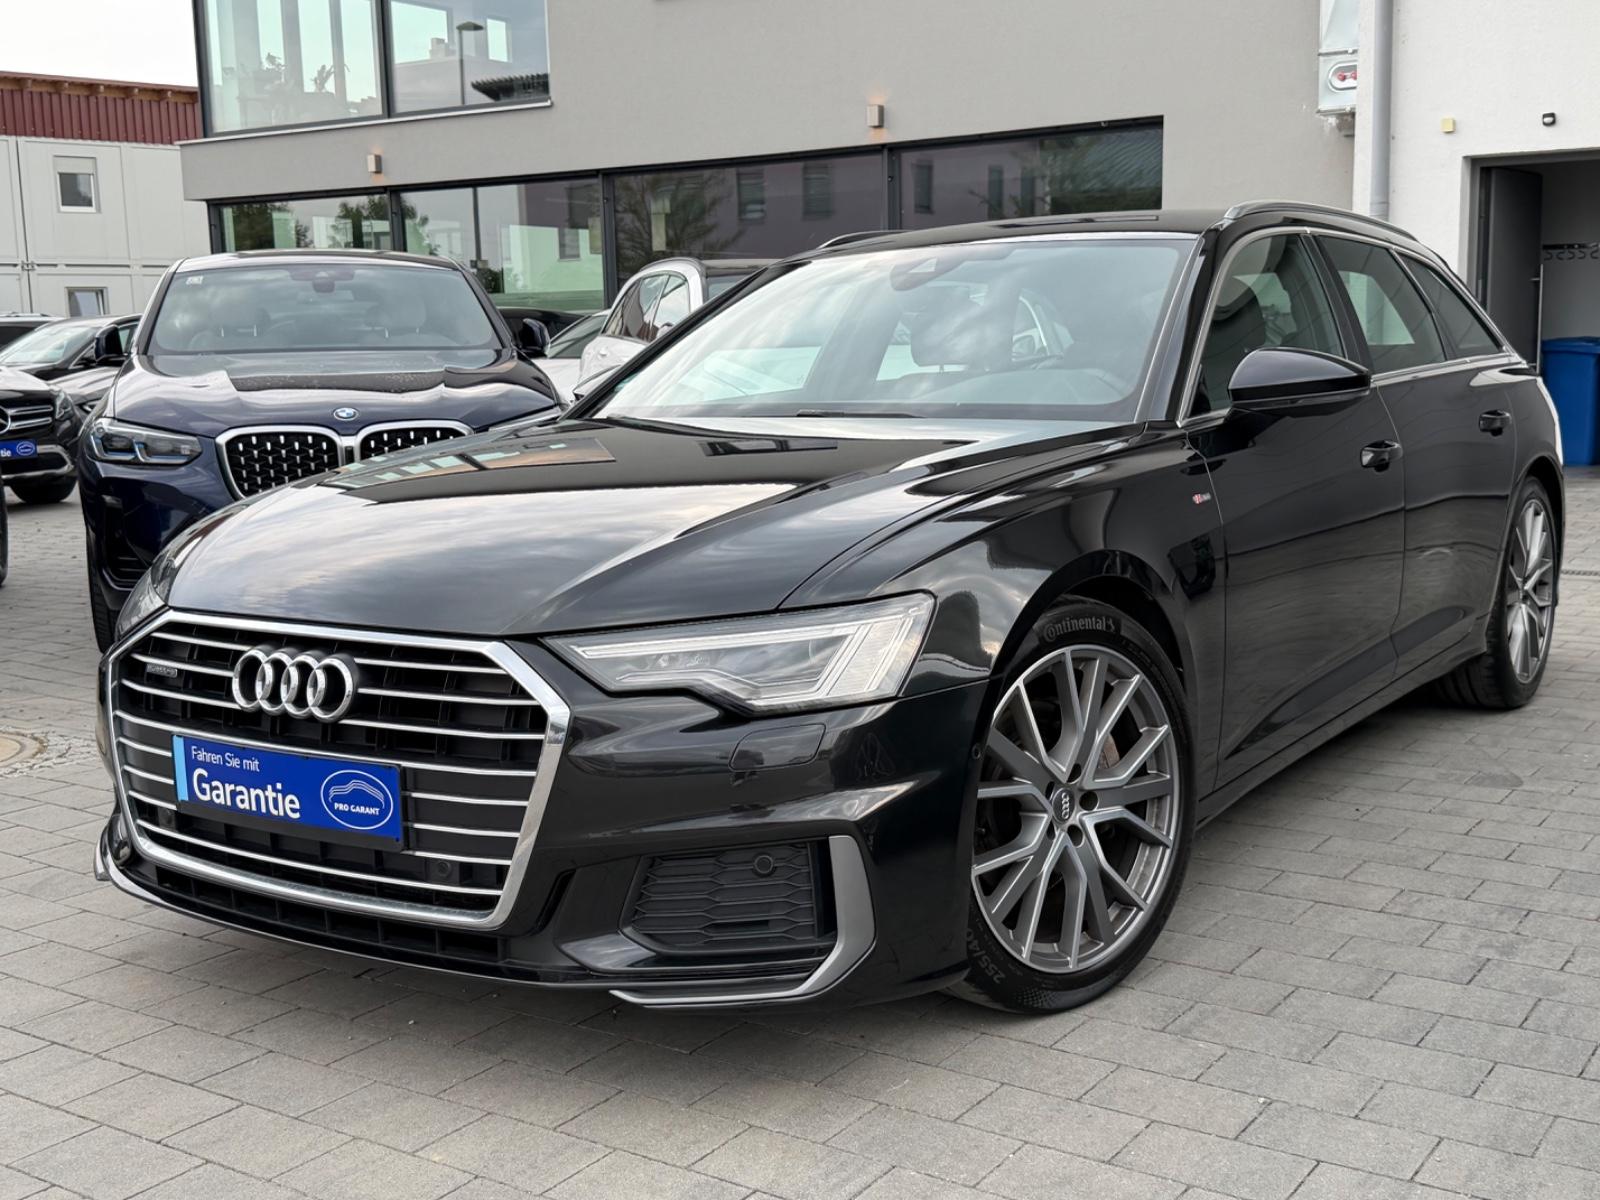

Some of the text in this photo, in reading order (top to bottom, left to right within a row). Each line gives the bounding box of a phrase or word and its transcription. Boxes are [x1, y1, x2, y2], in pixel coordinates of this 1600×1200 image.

[1043, 615, 1106, 642] Continental
[191, 745, 260, 772] Fahren Sie mit
[192, 767, 301, 819] Garantie
[334, 802, 381, 816] PRO GARANT
